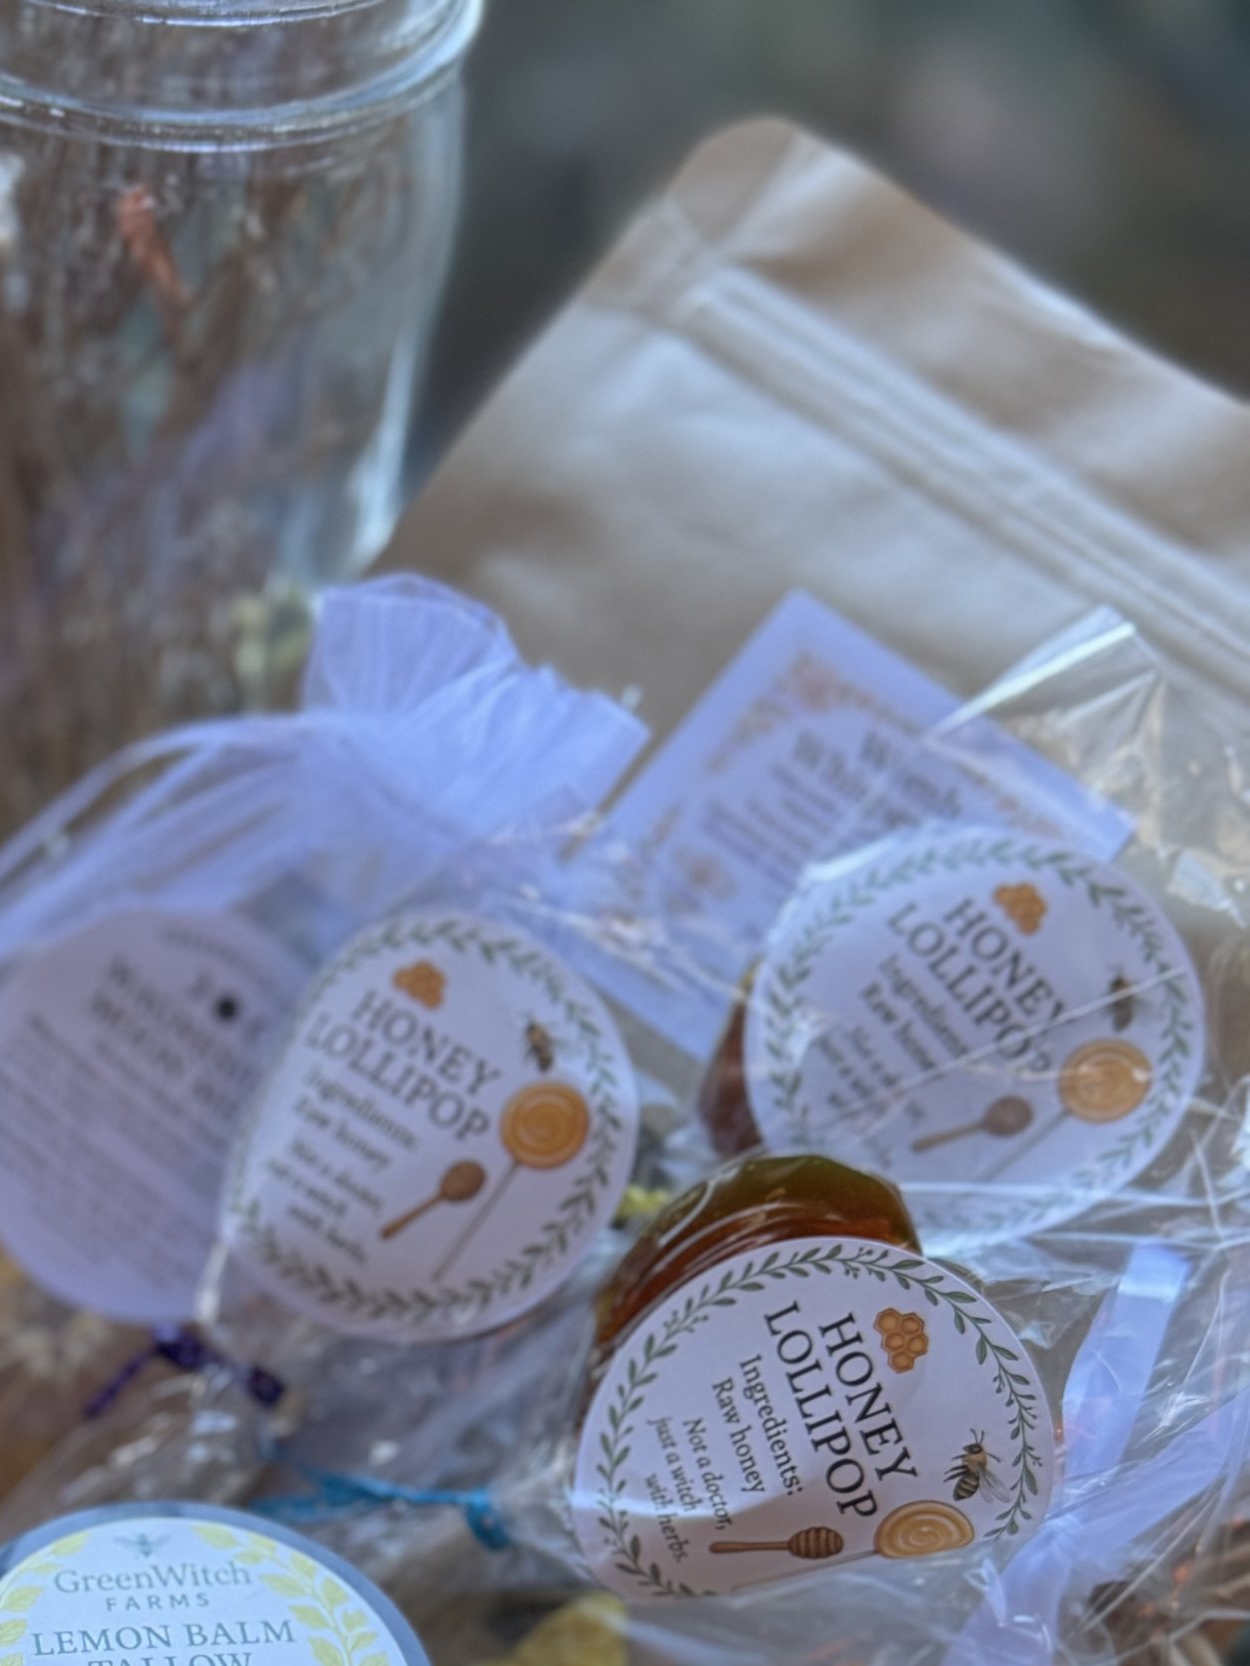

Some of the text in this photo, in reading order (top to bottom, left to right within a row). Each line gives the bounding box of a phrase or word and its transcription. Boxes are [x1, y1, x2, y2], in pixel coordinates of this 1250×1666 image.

[306, 1012, 491, 1141] LOLLIPOP
[352, 989, 502, 1096] HONEY
[683, 1418, 708, 1455] Not
[696, 1456, 711, 1470] a
[712, 1376, 766, 1495] Raw honey
[739, 1354, 803, 1496] Ingredients:
[763, 1300, 879, 1519] LOLLIPOP
[819, 1312, 918, 1483] HONEY
[670, 1466, 703, 1512] witch
[54, 1561, 254, 1595] GreenWitch
[105, 1592, 211, 1612] FARMS
[30, 1619, 298, 1657] LEMON BALM
